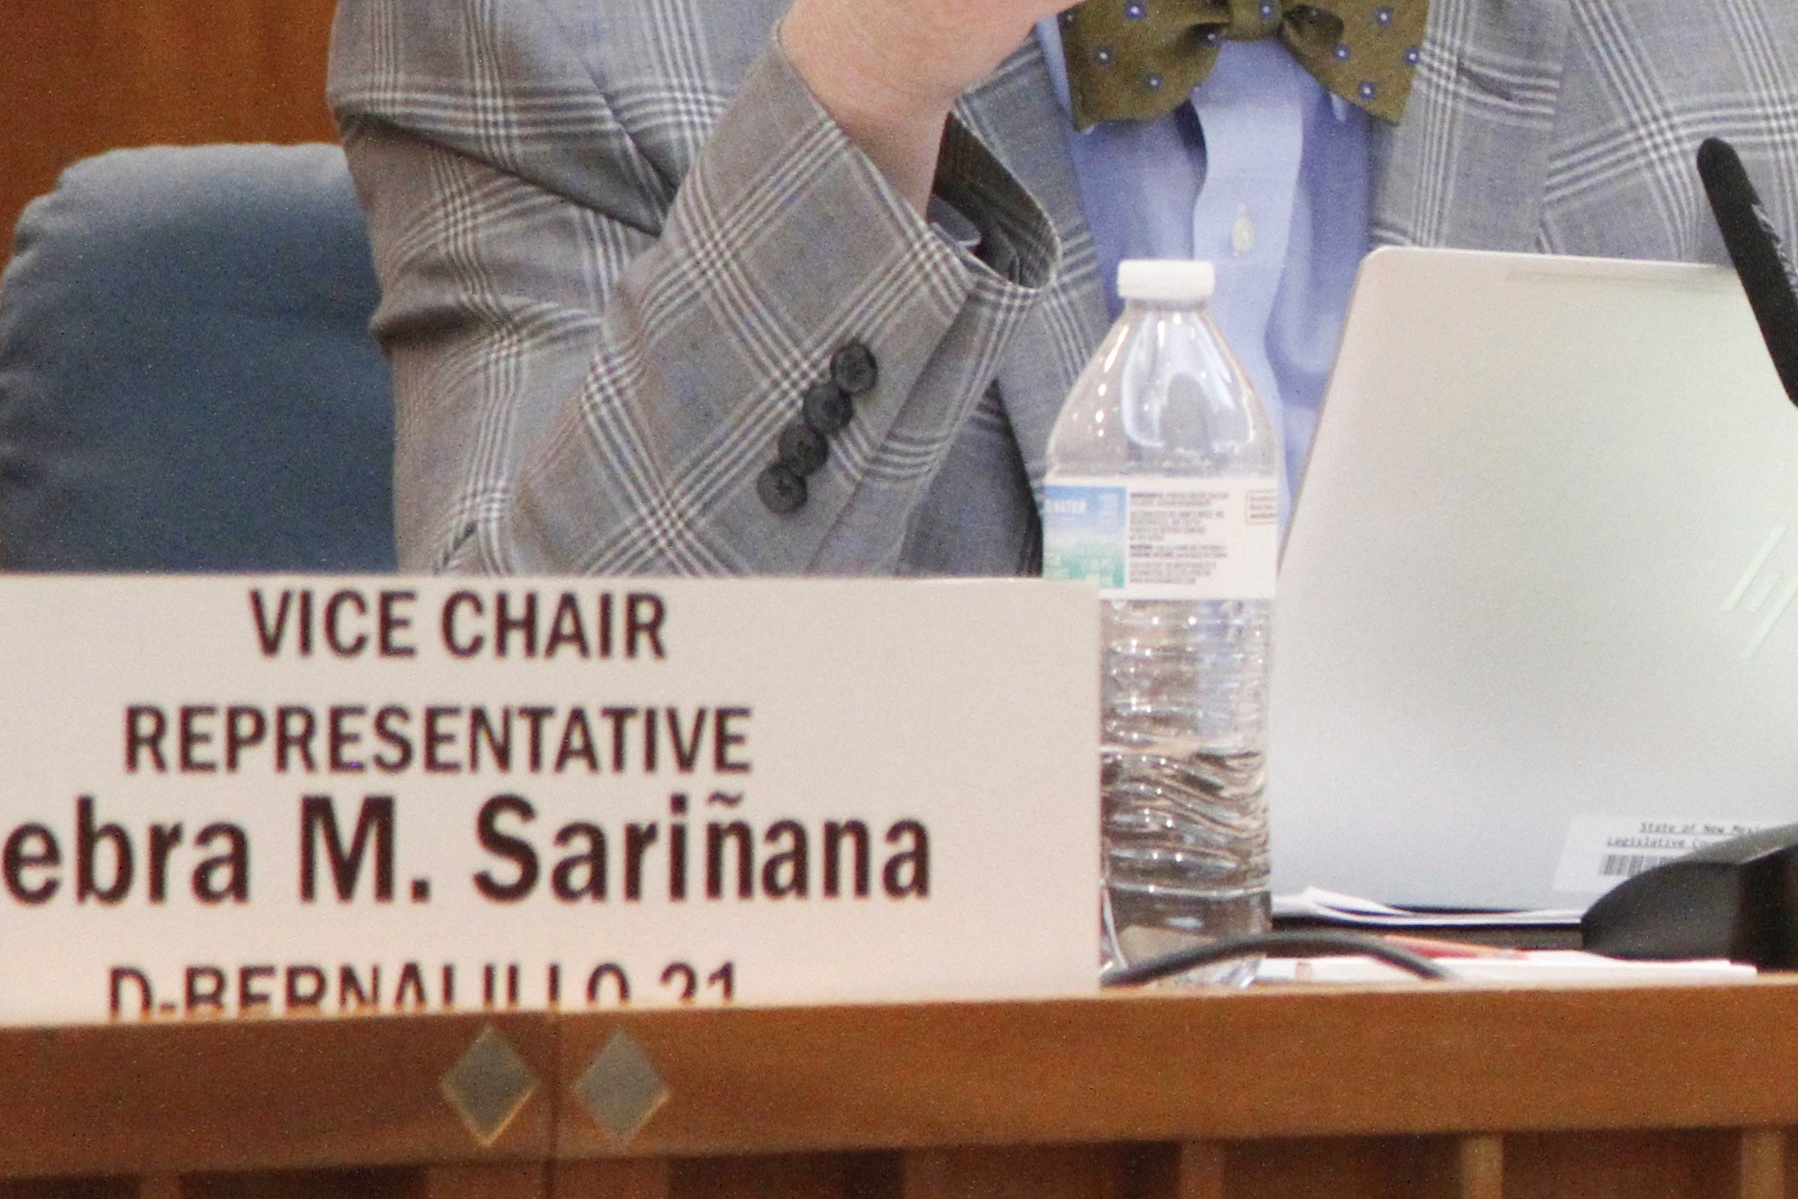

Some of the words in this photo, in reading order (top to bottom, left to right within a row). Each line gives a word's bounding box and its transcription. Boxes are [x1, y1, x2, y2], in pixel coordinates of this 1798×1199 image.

[249, 588, 416, 658] VICE
[441, 589, 666, 659] CHAIR
[124, 704, 751, 774] REPRESENTATIVE
[0, 794, 250, 906] ebra
[298, 793, 432, 904] M.
[472, 790, 931, 905] Sariñana
[1606, 835, 1686, 849] Legislative
[1639, 822, 1675, 834] State
[1681, 822, 1697, 834] of
[1703, 823, 1725, 835] New
